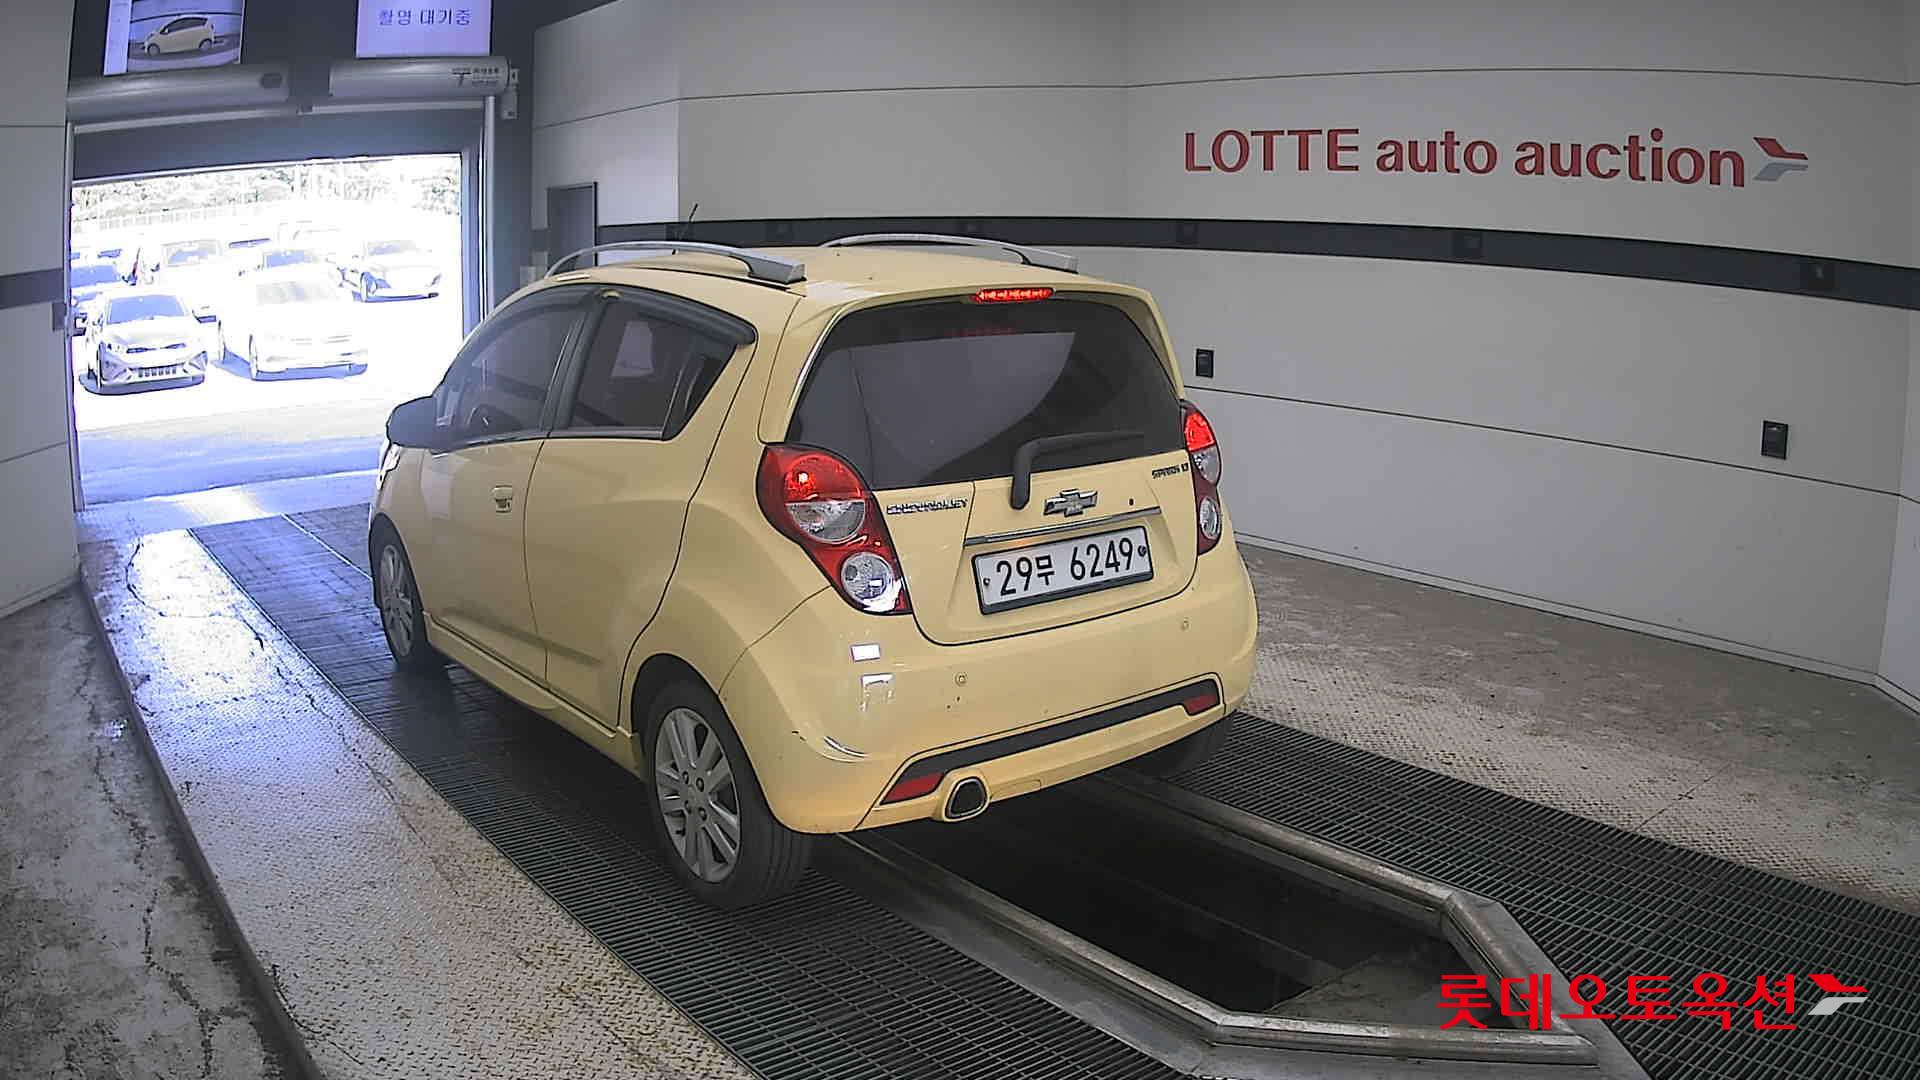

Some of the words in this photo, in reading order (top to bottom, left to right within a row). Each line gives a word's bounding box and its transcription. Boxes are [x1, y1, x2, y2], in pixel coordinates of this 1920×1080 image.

[420, 8, 471, 26] 대기중
[1185, 128, 1360, 173] LOTTE
[1375, 130, 1498, 175] auto
[1514, 128, 1746, 188] auction
[996, 554, 1055, 596] 29무
[1070, 536, 1134, 581] 6249
